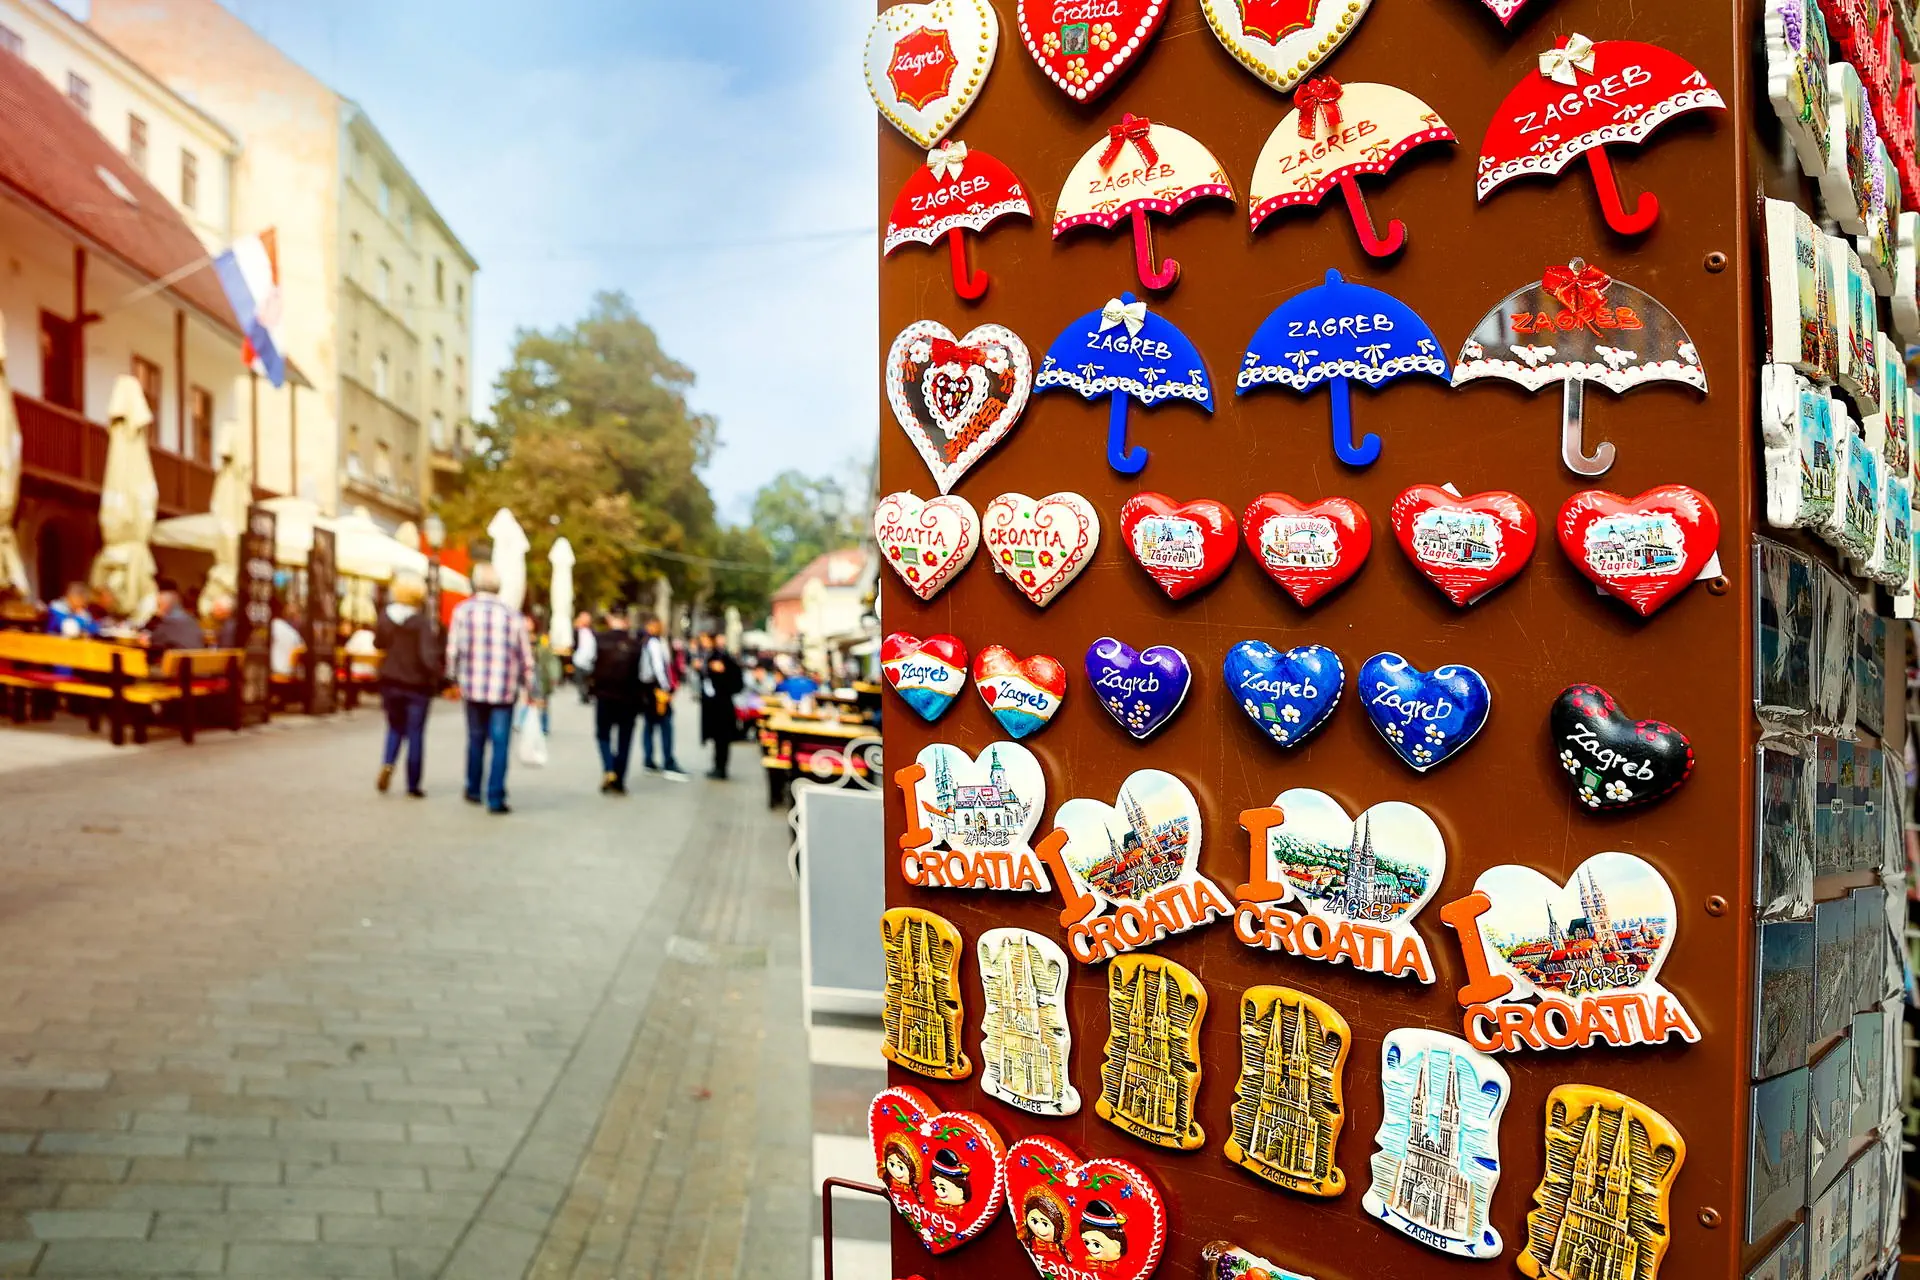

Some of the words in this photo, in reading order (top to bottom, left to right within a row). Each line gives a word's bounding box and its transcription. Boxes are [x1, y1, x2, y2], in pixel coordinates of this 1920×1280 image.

[894, 45, 944, 76] Zagreb
[1514, 65, 1652, 134] ZAGREB
[1279, 120, 1378, 174] ZAGREB
[911, 175, 990, 211] ZAGREB
[1090, 163, 1175, 193] ZAGREB
[1288, 313, 1394, 339] ZAGREB
[1087, 331, 1172, 361] ZAGREB
[879, 525, 947, 547] CROATIA
[989, 527, 1066, 549] CROATIA
[1150, 548, 1186, 564] Zagreb
[1422, 546, 1460, 561] Zagreb
[1599, 559, 1640, 573] Zagreb
[901, 663, 949, 686] Zagreb
[1097, 666, 1160, 699] Zagreb
[1240, 669, 1318, 700] Zagreb
[998, 680, 1049, 711] Zagreb
[1371, 681, 1453, 726] Zagreb
[1566, 722, 1654, 781] Zagreb
[894, 763, 933, 849] I
[963, 828, 1010, 848] ZAGREB
[901, 849, 1042, 890] CROATIA
[1235, 804, 1285, 904] I
[1035, 827, 1096, 928] I
[1128, 860, 1180, 894] ZAGREB
[1067, 880, 1228, 964] CROATIA
[1323, 892, 1393, 923] ZAGREB
[1233, 901, 1429, 982] CROATIA
[1439, 889, 1514, 1007] I
[1566, 964, 1640, 991] ZAGREB
[1463, 993, 1696, 1053] CROATIA
[907, 1060, 936, 1077] ZAGREB
[1011, 1096, 1042, 1113] ZAGREB
[1127, 1122, 1161, 1143] ZAGREB
[1260, 1165, 1298, 1189] ZAGREB
[893, 1191, 957, 1234] Zagreb
[1405, 1222, 1448, 1249] ZAGREB
